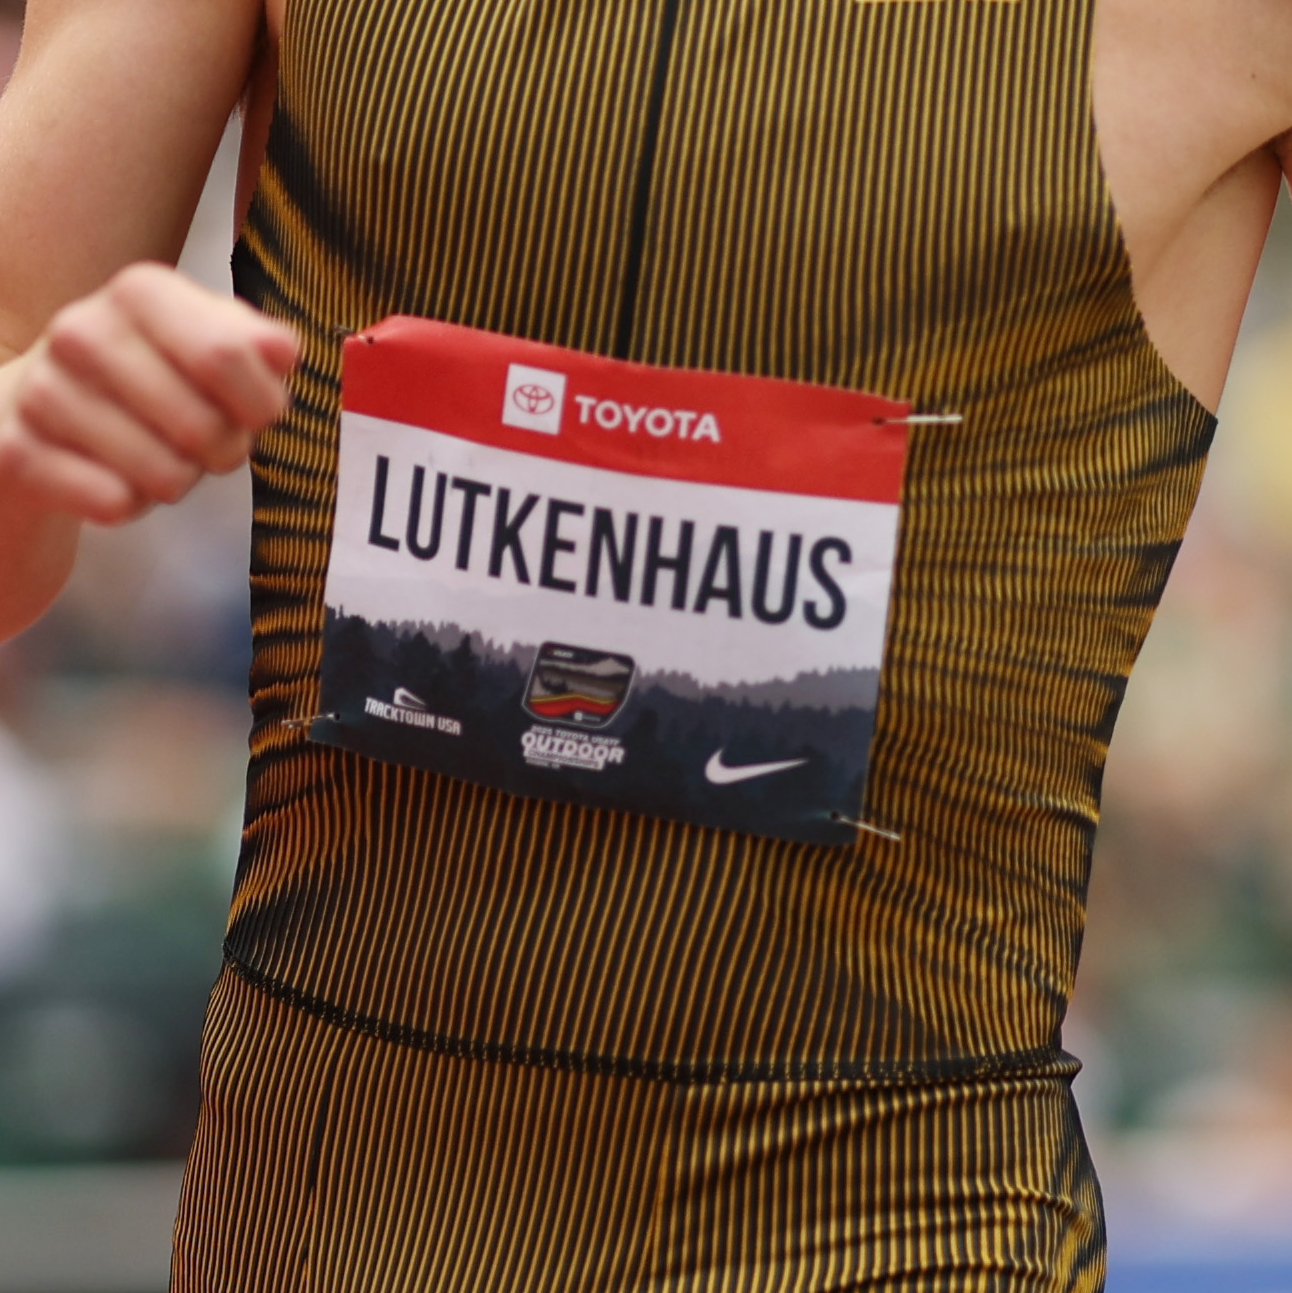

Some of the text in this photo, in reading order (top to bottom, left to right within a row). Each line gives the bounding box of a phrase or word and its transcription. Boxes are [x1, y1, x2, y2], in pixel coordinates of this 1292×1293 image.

[574, 394, 721, 443] TOYOTA
[367, 454, 853, 631] LUTKENHAUS
[364, 696, 461, 736] TRACKTOWN USA
[555, 728, 589, 742] TOYOTA
[521, 731, 625, 764] OUTDOOR
